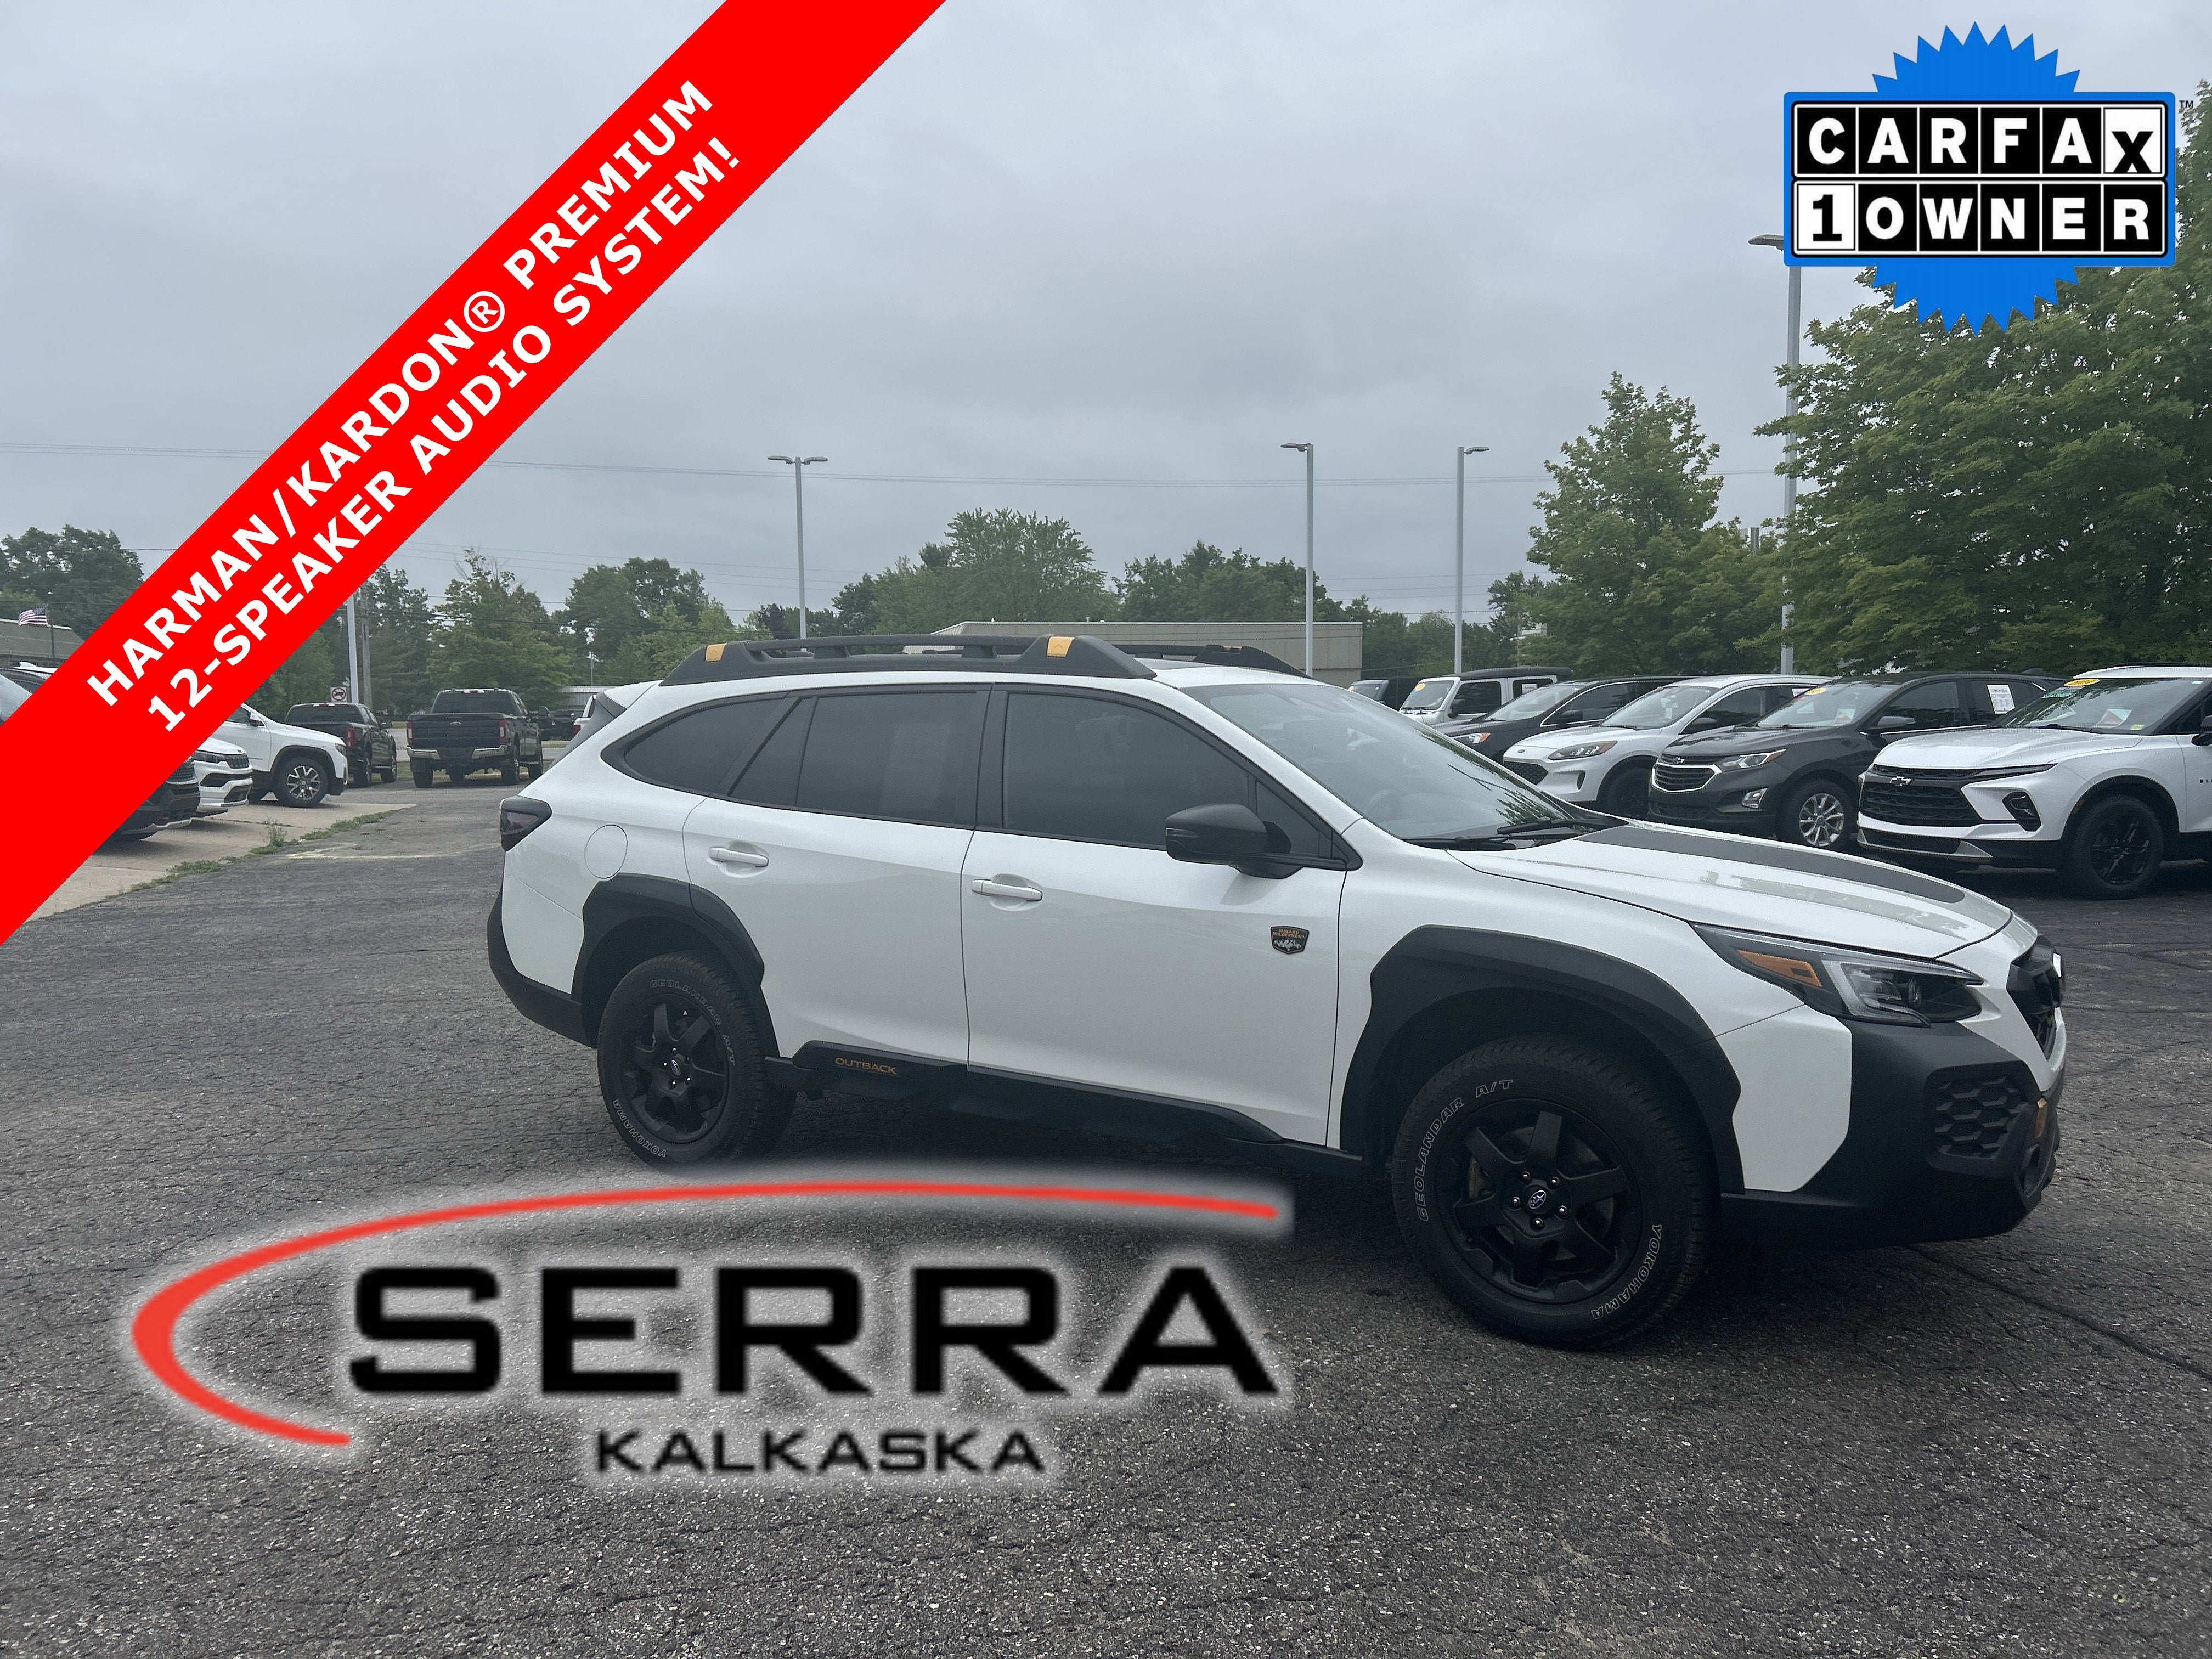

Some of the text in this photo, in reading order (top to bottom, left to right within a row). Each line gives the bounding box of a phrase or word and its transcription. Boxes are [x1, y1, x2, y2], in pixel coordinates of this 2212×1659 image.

[834, 1057, 897, 1075] OUTBACK
[613, 1099, 667, 1158] YOKOHAMA
[1414, 1079, 1514, 1222] GEOLANDAR A/T
[1590, 1224, 1662, 1320] YOKOHAMA
